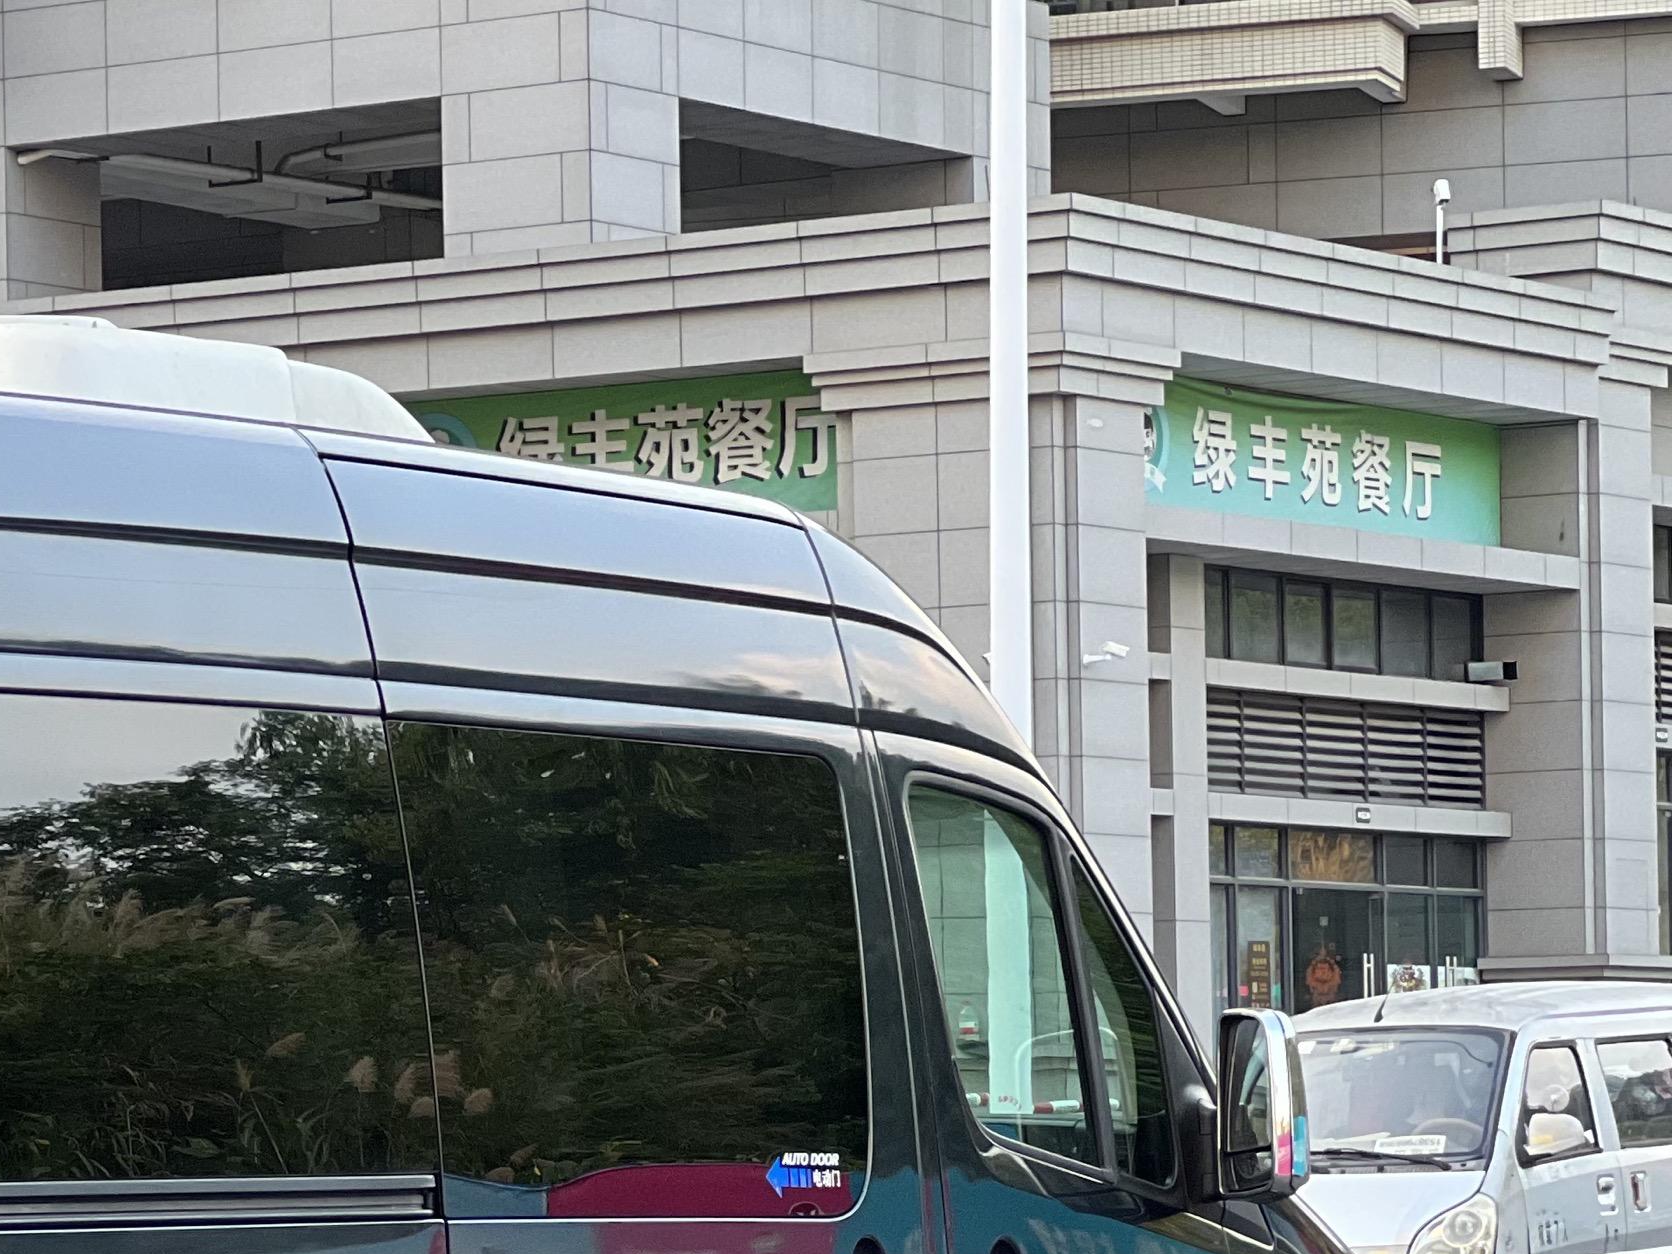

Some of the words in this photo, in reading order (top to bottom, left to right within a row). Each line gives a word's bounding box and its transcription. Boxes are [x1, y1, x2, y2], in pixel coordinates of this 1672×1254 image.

[1192, 407, 1442, 519] 绿丰苑餐厅
[782, 1152, 809, 1166] AUTO
[810, 1153, 840, 1166] DOOR
[813, 1169, 841, 1188] 电动门
